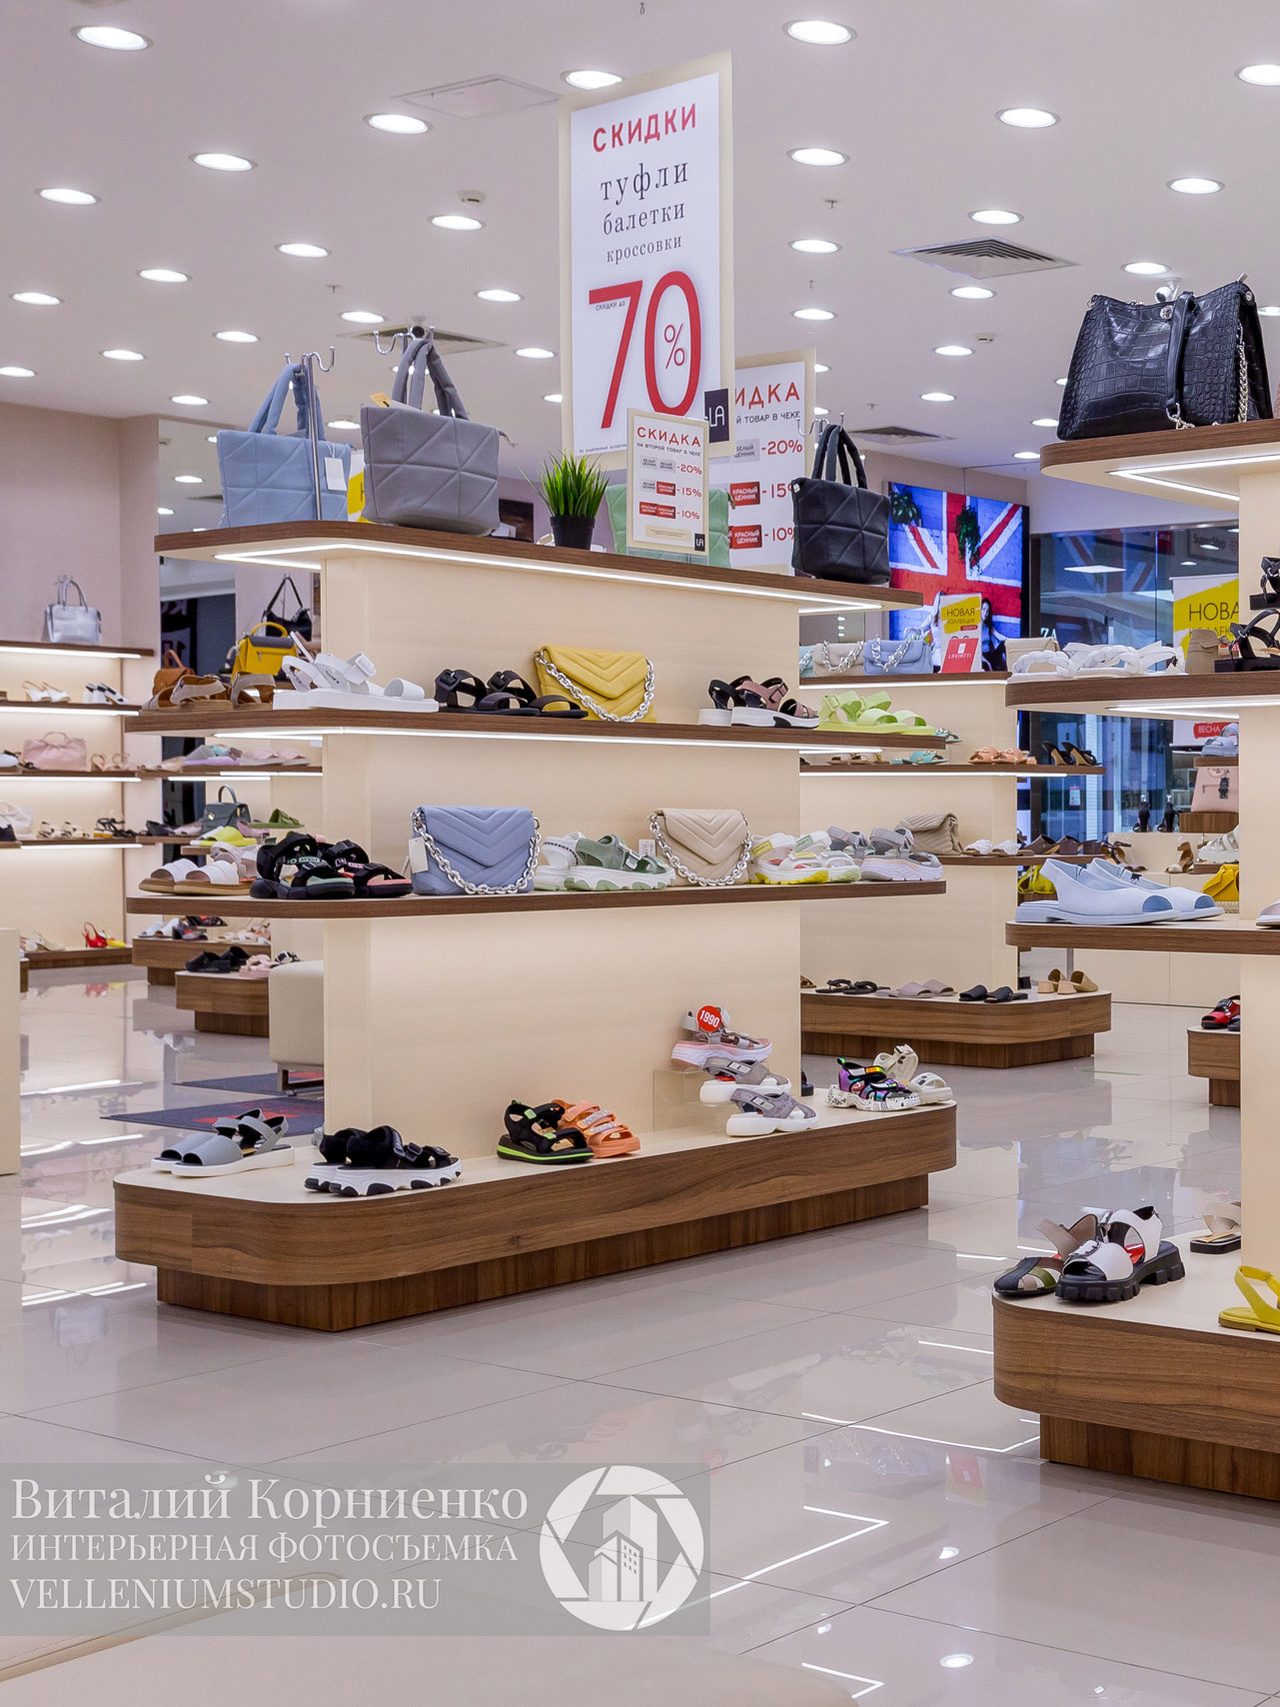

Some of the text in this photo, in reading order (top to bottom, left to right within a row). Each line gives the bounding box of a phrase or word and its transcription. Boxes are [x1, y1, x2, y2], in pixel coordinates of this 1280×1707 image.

[593, 103, 696, 153] СКИДКИ
[600, 162, 688, 206] туфли
[603, 202, 685, 236] балетки
[606, 236, 682, 265] кроссовки
[745, 414, 770, 424] ТОВАР
[772, 413, 778, 421] В
[781, 411, 800, 419] ЧЕКЕ
[637, 426, 701, 447] СКИДКА
[761, 439, 803, 455] -20%
[677, 463, 703, 475] -20%
[677, 486, 702, 498] -15%
[762, 482, 792, 498] -15
[677, 509, 700, 520] -10%
[946, 608, 975, 617] НОВАЯ
[699, 1010, 720, 1028] 1990
